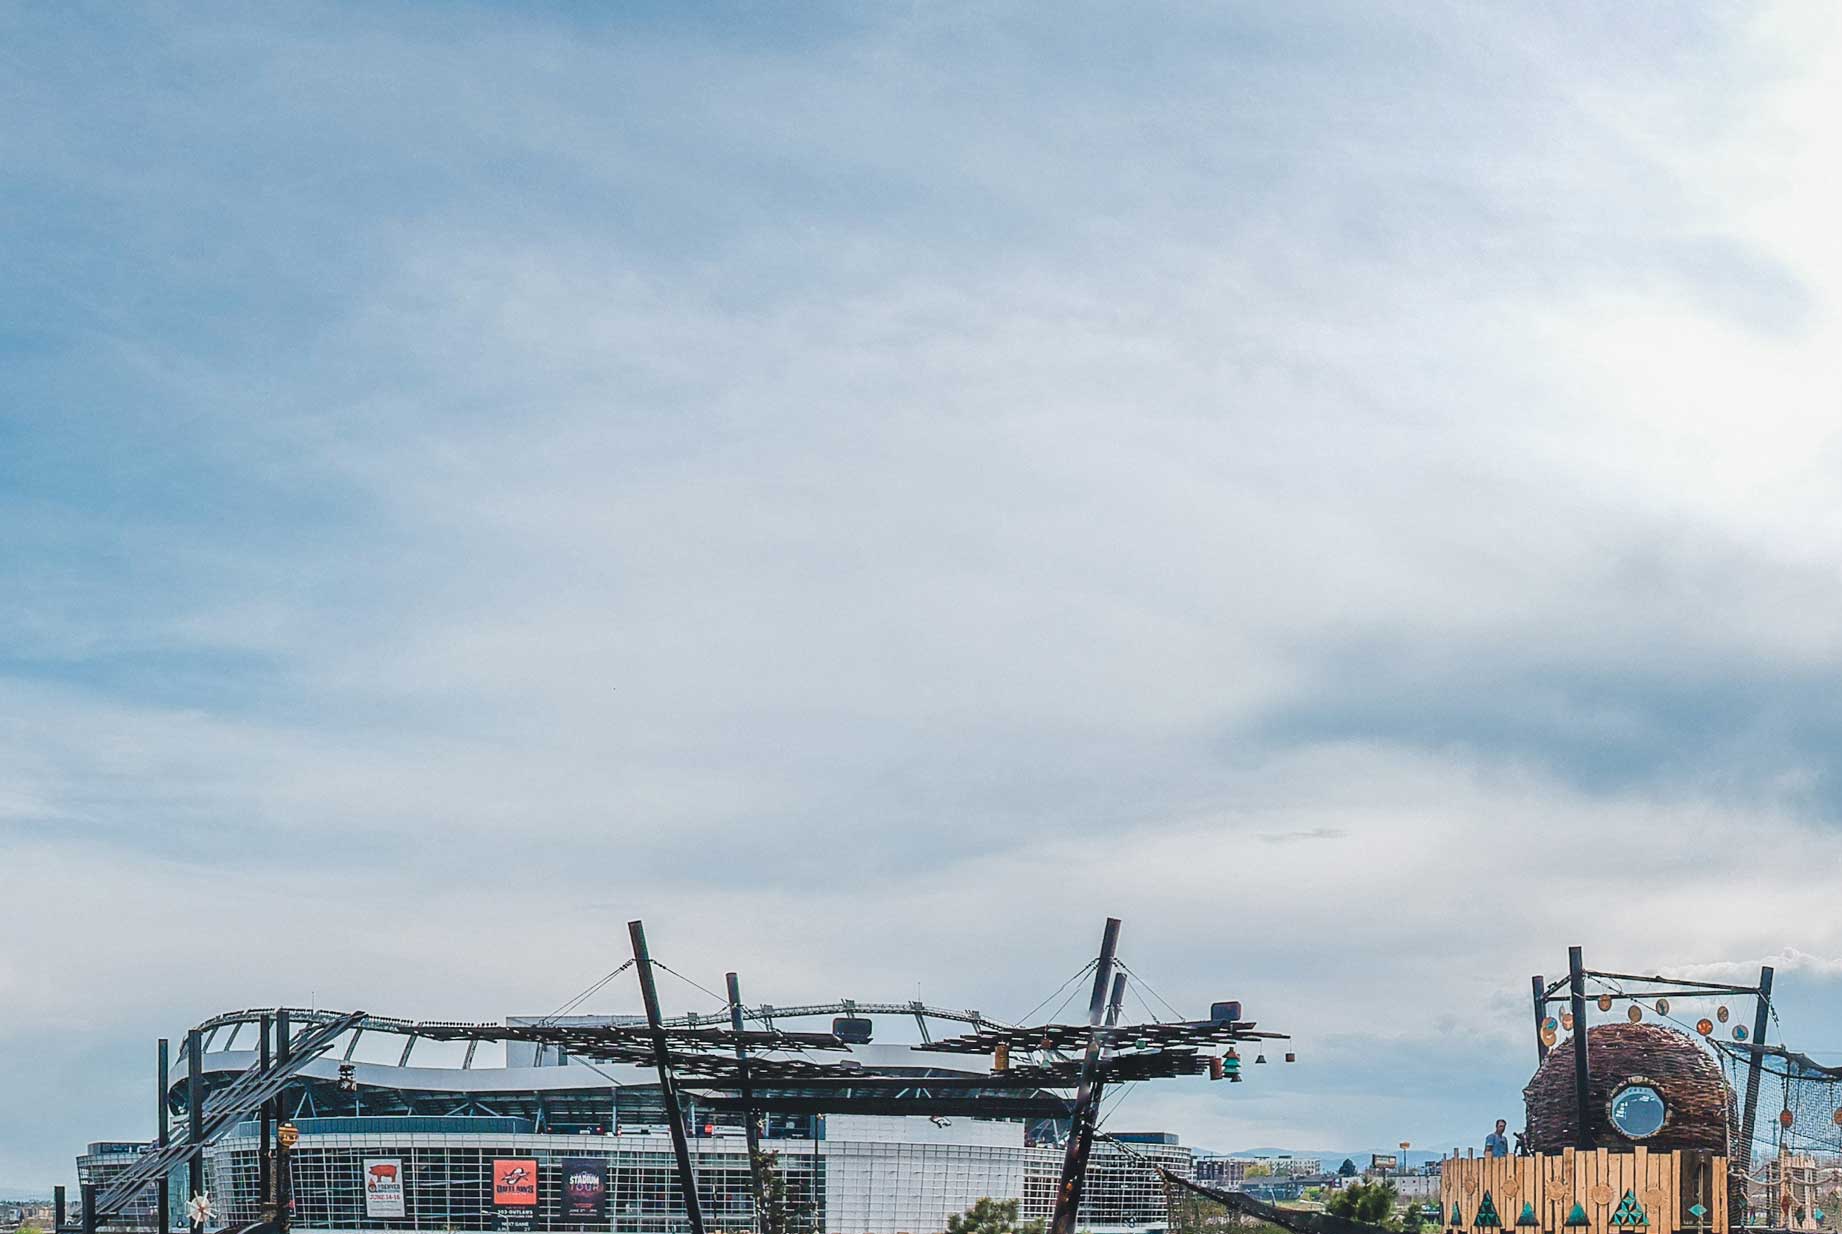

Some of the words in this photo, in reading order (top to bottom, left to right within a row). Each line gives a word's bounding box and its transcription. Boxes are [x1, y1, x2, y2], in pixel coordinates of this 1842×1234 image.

[569, 1175, 599, 1184] STADIUM
[496, 1184, 534, 1193] OUTLAWS
[570, 1183, 599, 1191] TOUR
